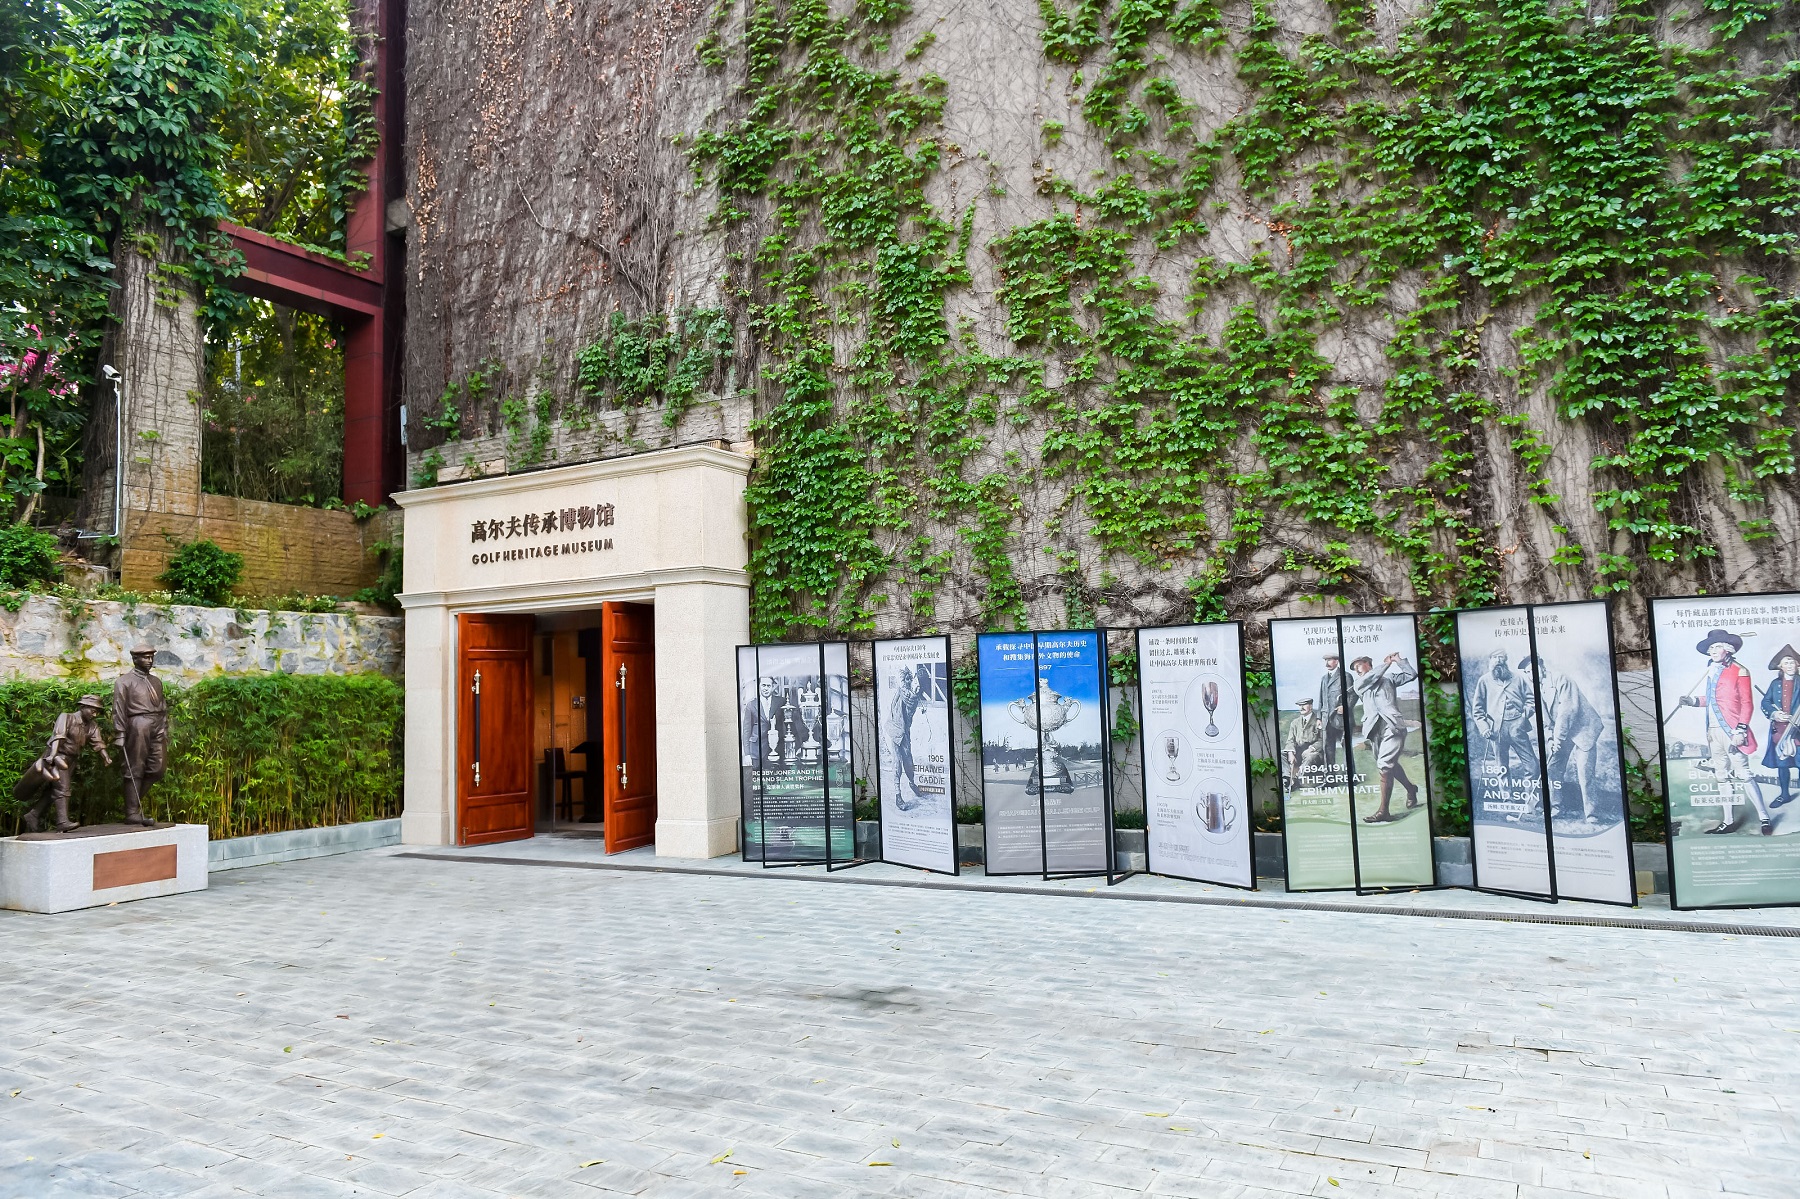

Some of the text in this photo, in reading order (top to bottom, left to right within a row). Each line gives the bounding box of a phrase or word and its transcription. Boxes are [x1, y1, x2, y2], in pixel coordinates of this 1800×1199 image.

[471, 503, 615, 543] 高尔夫传承博物馆
[472, 538, 614, 565] GOLF HERITAGE MUSEUM
[1500, 614, 1559, 627] 连接古的桥梁
[1303, 624, 1383, 636] 呈现历史的人物掌故
[928, 754, 944, 762] 1905
[918, 775, 945, 784] CADDIE
[1300, 774, 1367, 784] THE GREAT
[1482, 778, 1562, 790] TOM MORIS
[1300, 785, 1381, 796] TRIUMVIRATE
[1484, 790, 1540, 801] AND SON
